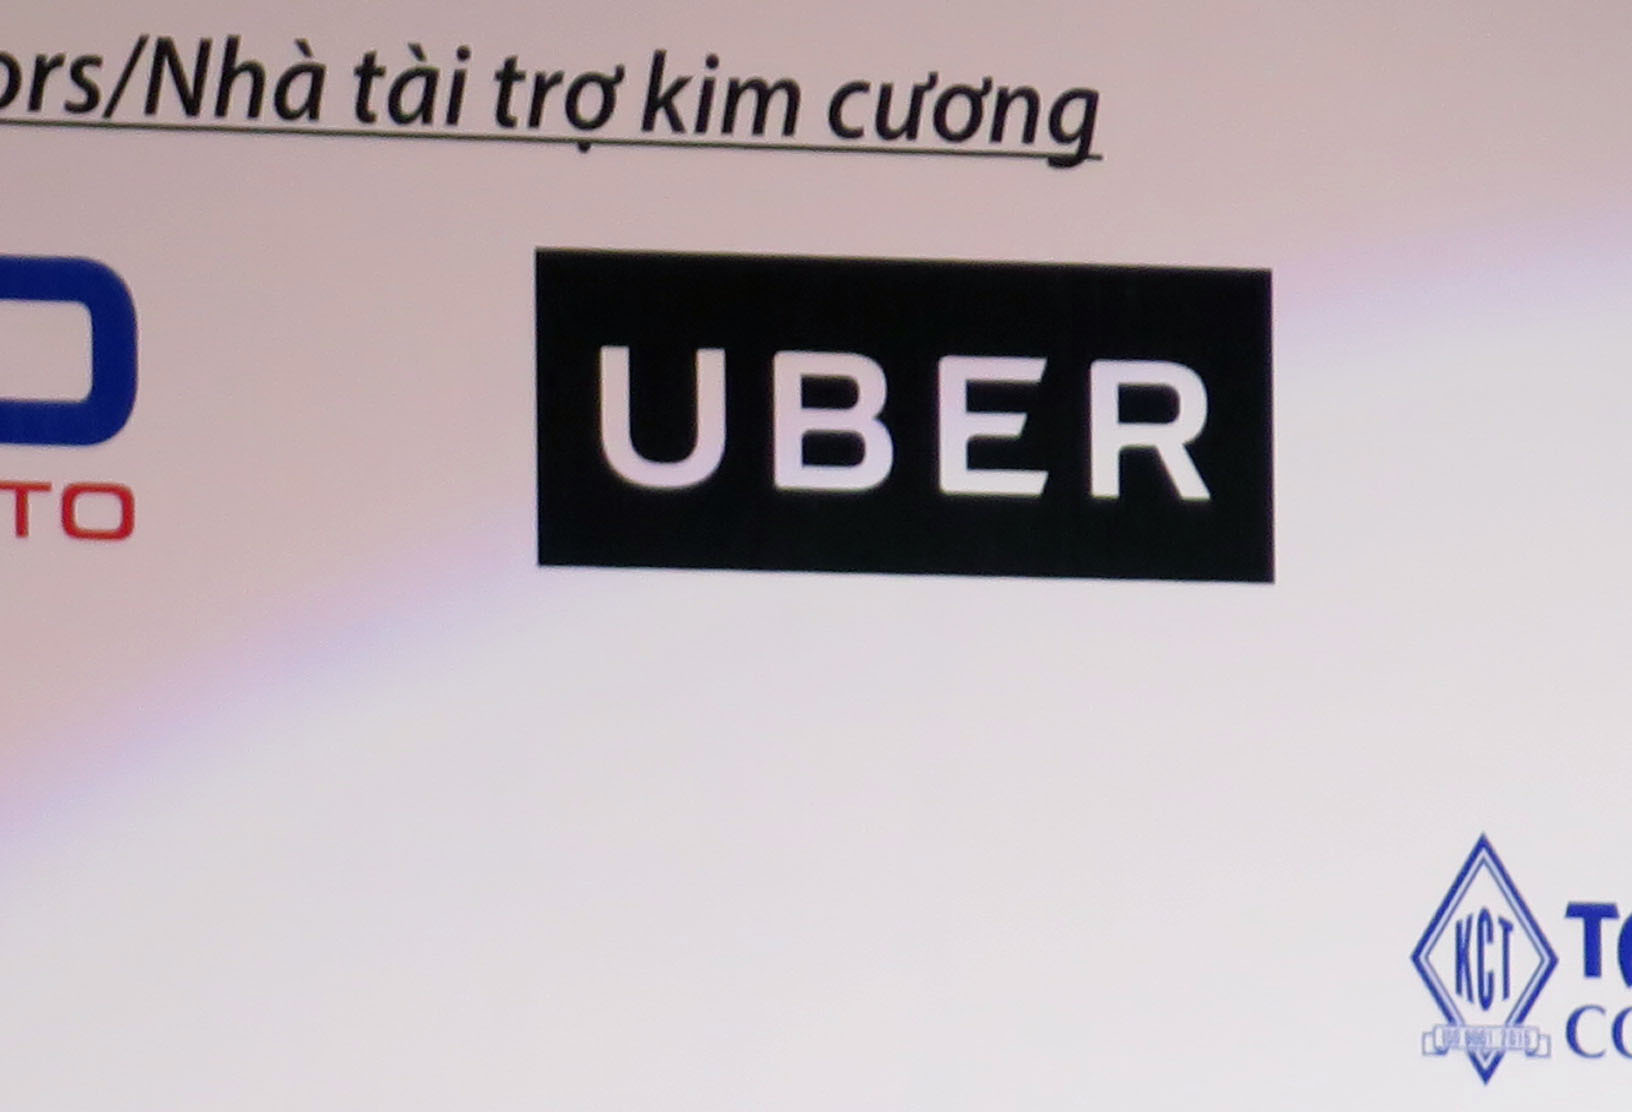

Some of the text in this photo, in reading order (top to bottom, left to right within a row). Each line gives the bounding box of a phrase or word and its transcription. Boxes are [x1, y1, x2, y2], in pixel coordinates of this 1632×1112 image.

[354, 44, 472, 127] tài
[495, 56, 626, 152] trợ
[641, 50, 801, 137] kim
[828, 73, 1101, 167] cương
[599, 346, 1211, 500] UBER
[1454, 906, 1514, 1012] KCT
